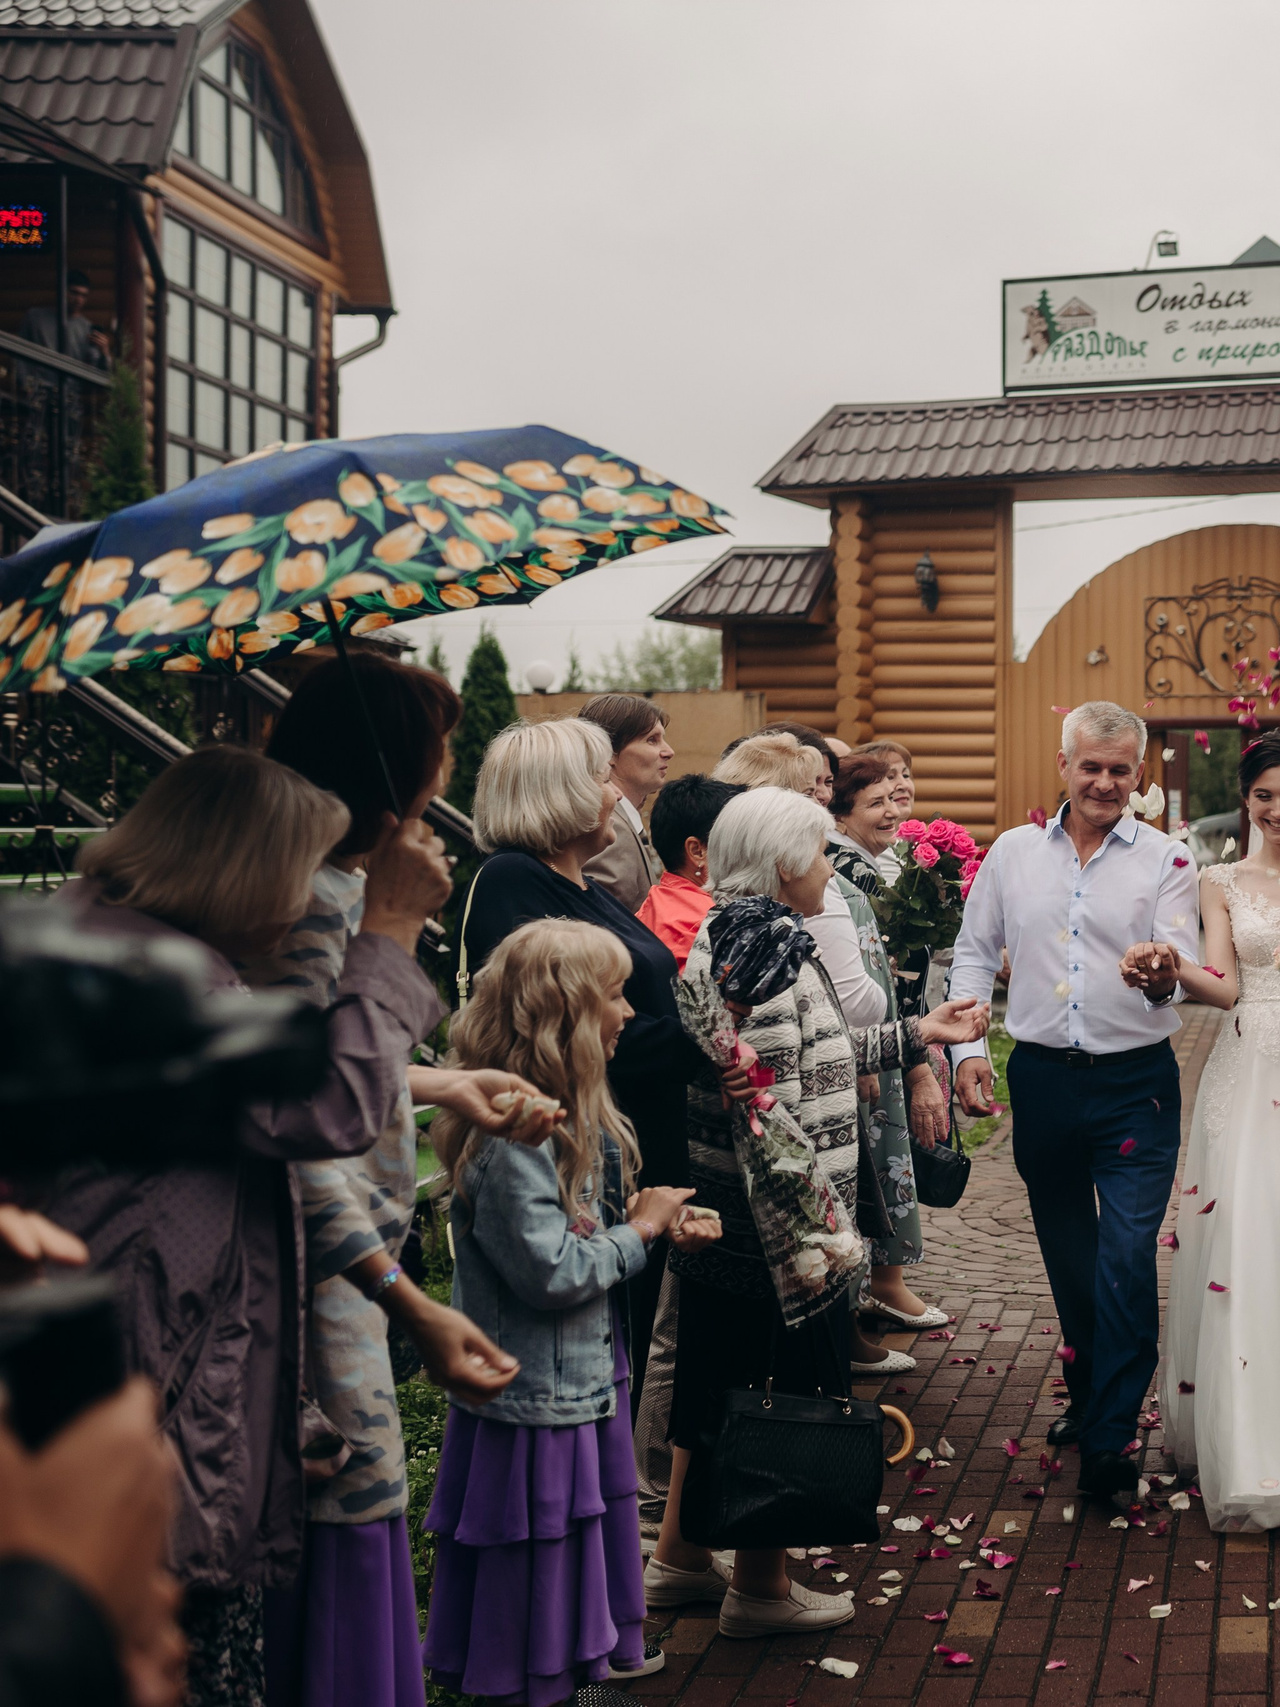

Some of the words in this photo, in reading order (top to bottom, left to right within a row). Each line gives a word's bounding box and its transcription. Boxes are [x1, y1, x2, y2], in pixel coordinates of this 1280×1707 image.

[1136, 282, 1252, 312] Отдых
[1164, 320, 1180, 334] в
[1172, 347, 1188, 362] с
